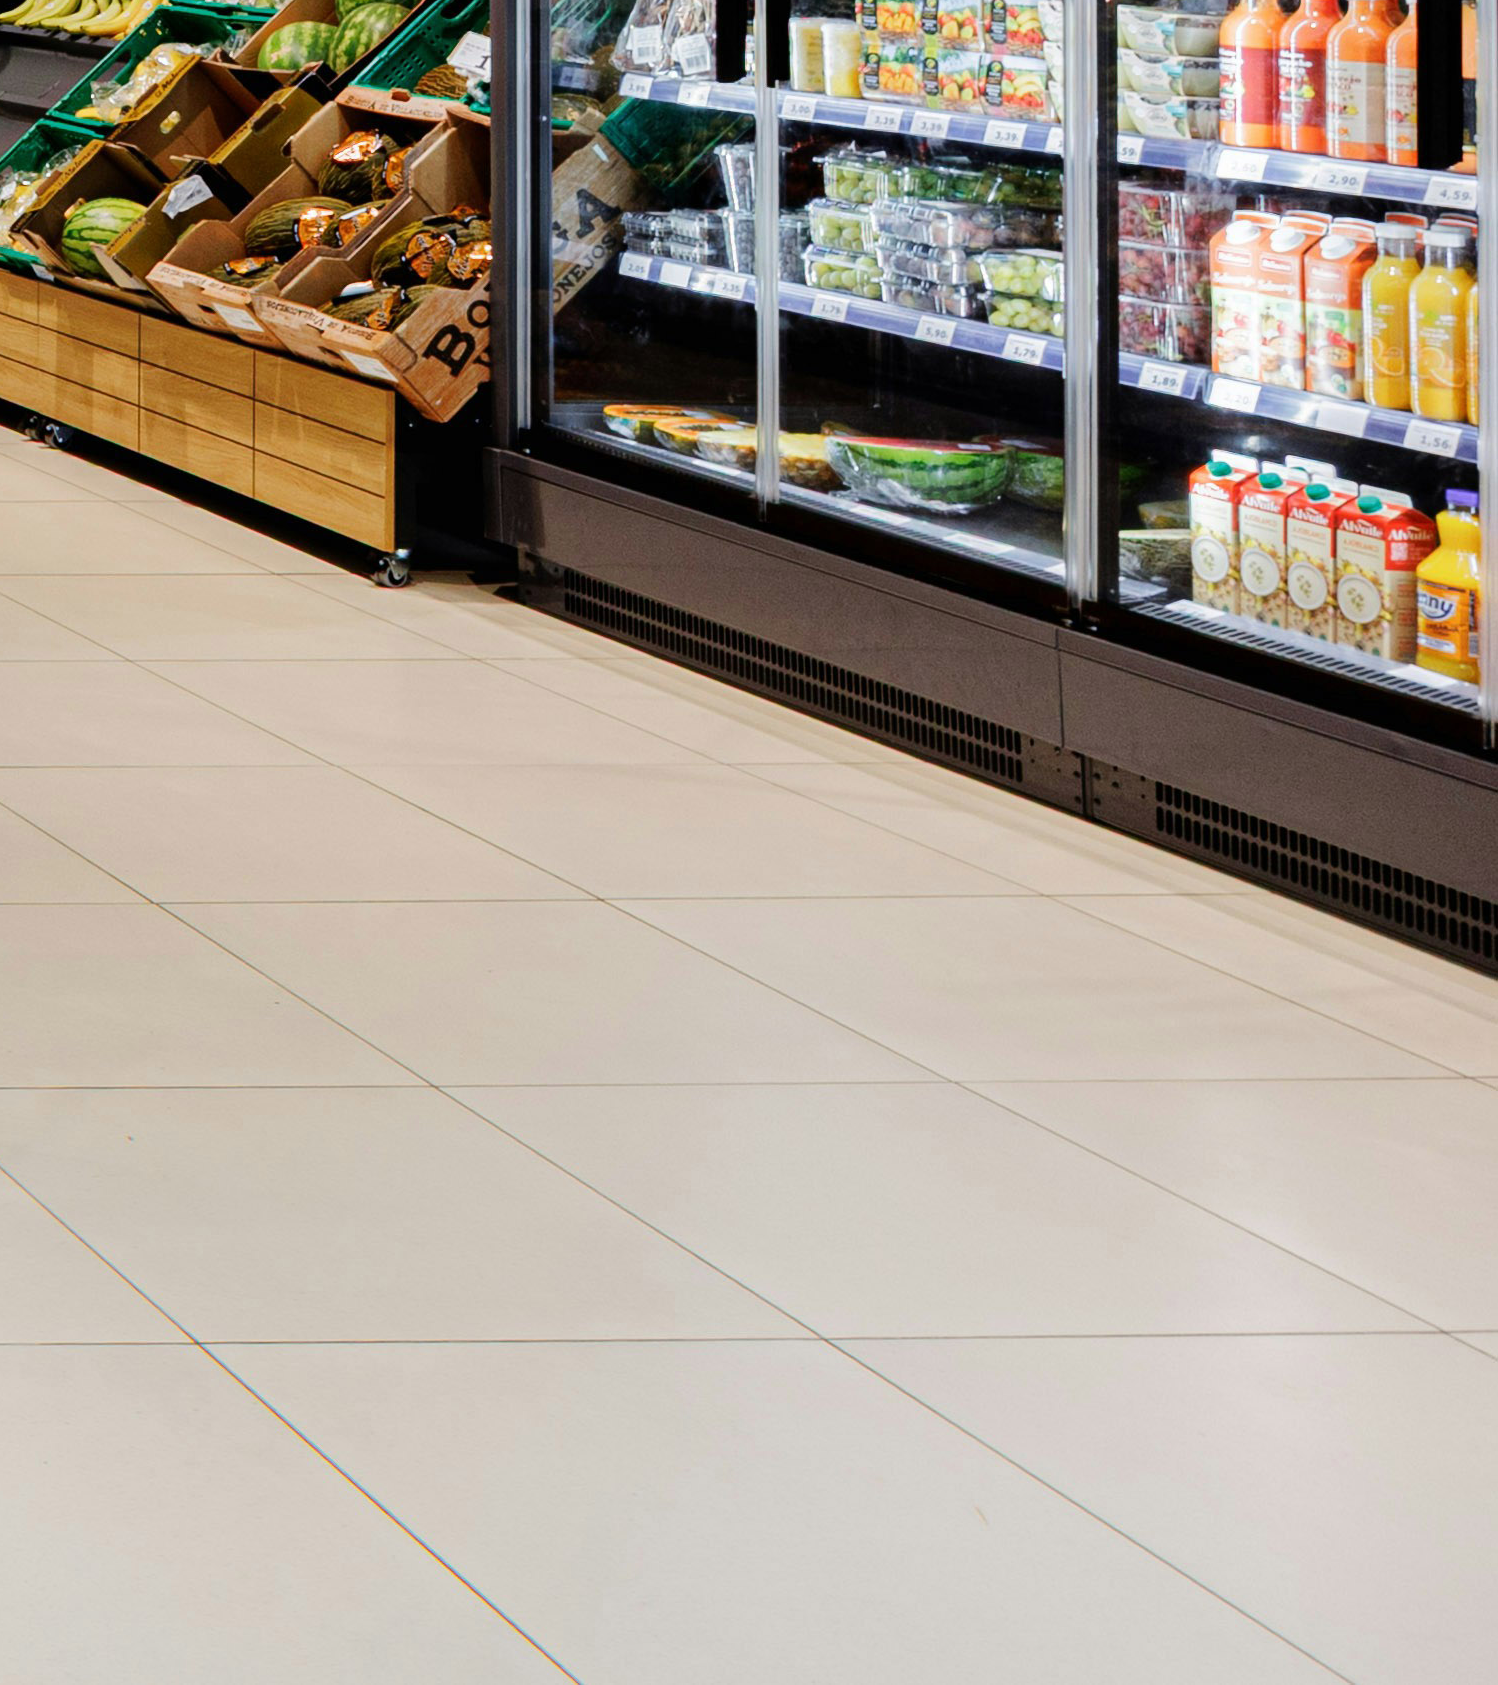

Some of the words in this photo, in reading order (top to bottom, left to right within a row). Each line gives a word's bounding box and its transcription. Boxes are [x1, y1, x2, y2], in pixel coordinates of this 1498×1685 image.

[1241, 495, 1281, 513] Alvalle
[1290, 507, 1329, 526] Alvalle
[1339, 519, 1383, 538] Alvalle
